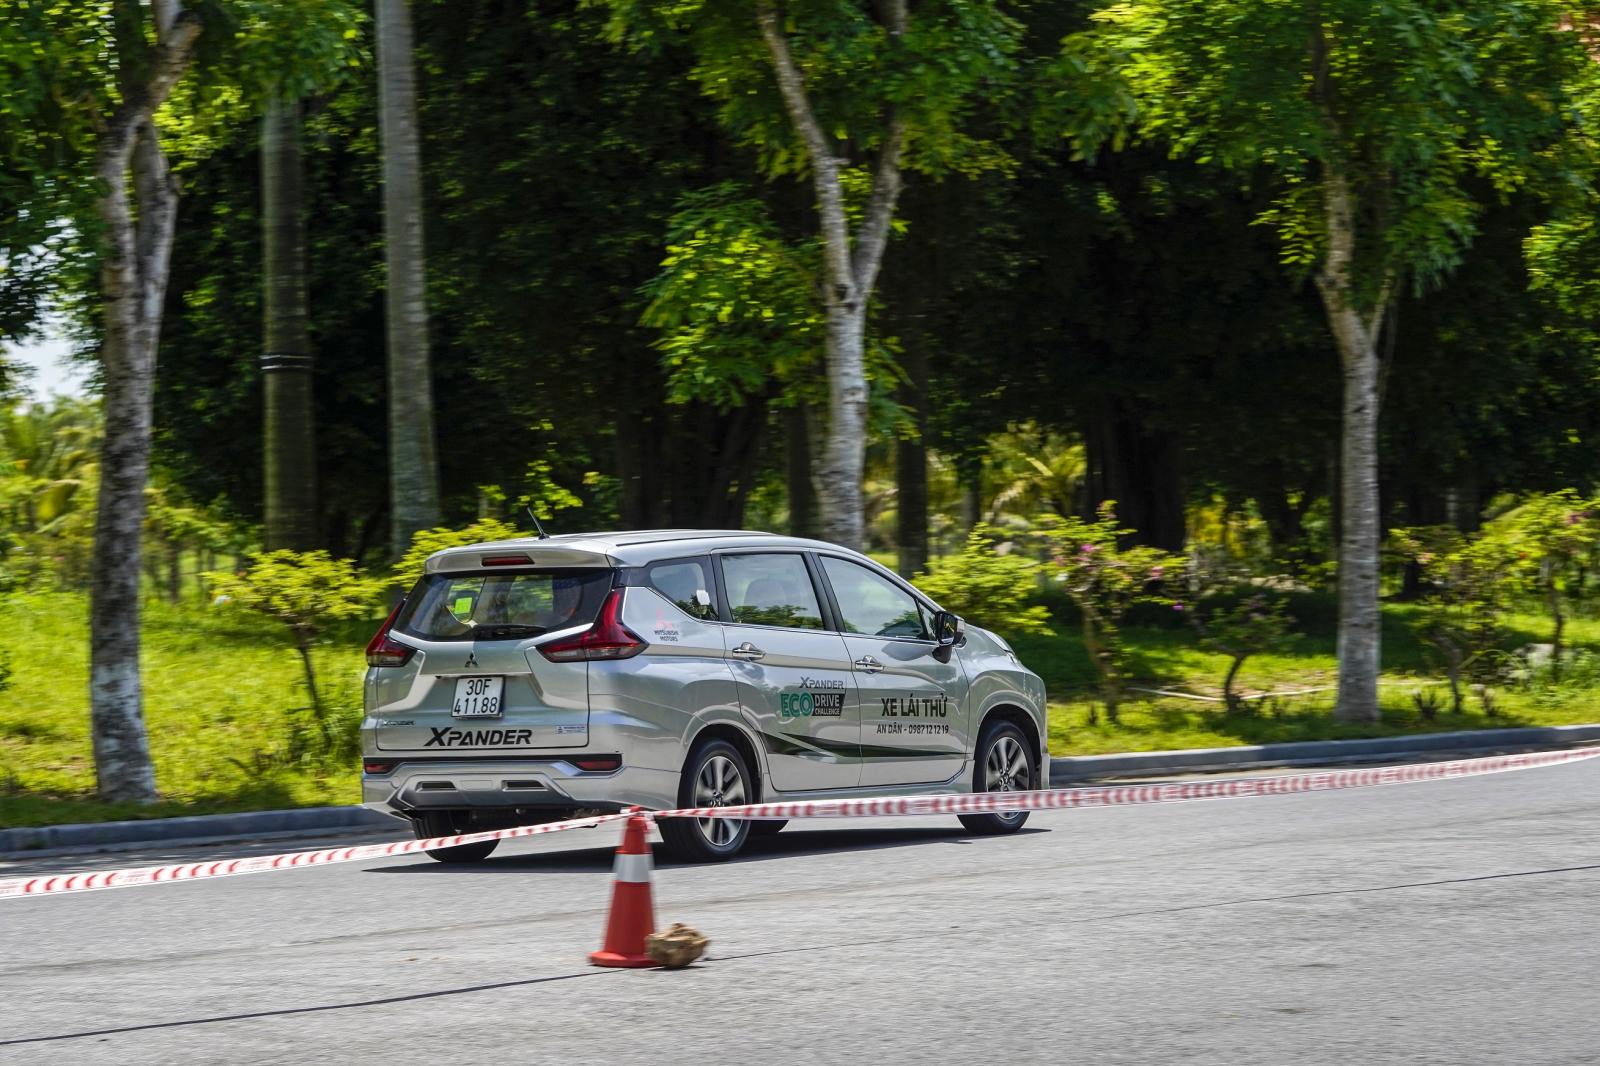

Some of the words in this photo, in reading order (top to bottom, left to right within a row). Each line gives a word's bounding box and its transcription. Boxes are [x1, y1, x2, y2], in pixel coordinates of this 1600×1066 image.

[466, 679, 492, 695] 30F
[800, 676, 845, 689] XPANDER
[453, 697, 498, 714] 411.88
[780, 692, 813, 717] ECO
[814, 694, 840, 707] DRIVE
[881, 698, 898, 717] XE
[901, 693, 919, 717] LÁI
[921, 692, 948, 717] THỬ
[814, 707, 840, 715] CHALLENGE
[423, 726, 533, 747] XPANDER
[877, 724, 887, 734] AN
